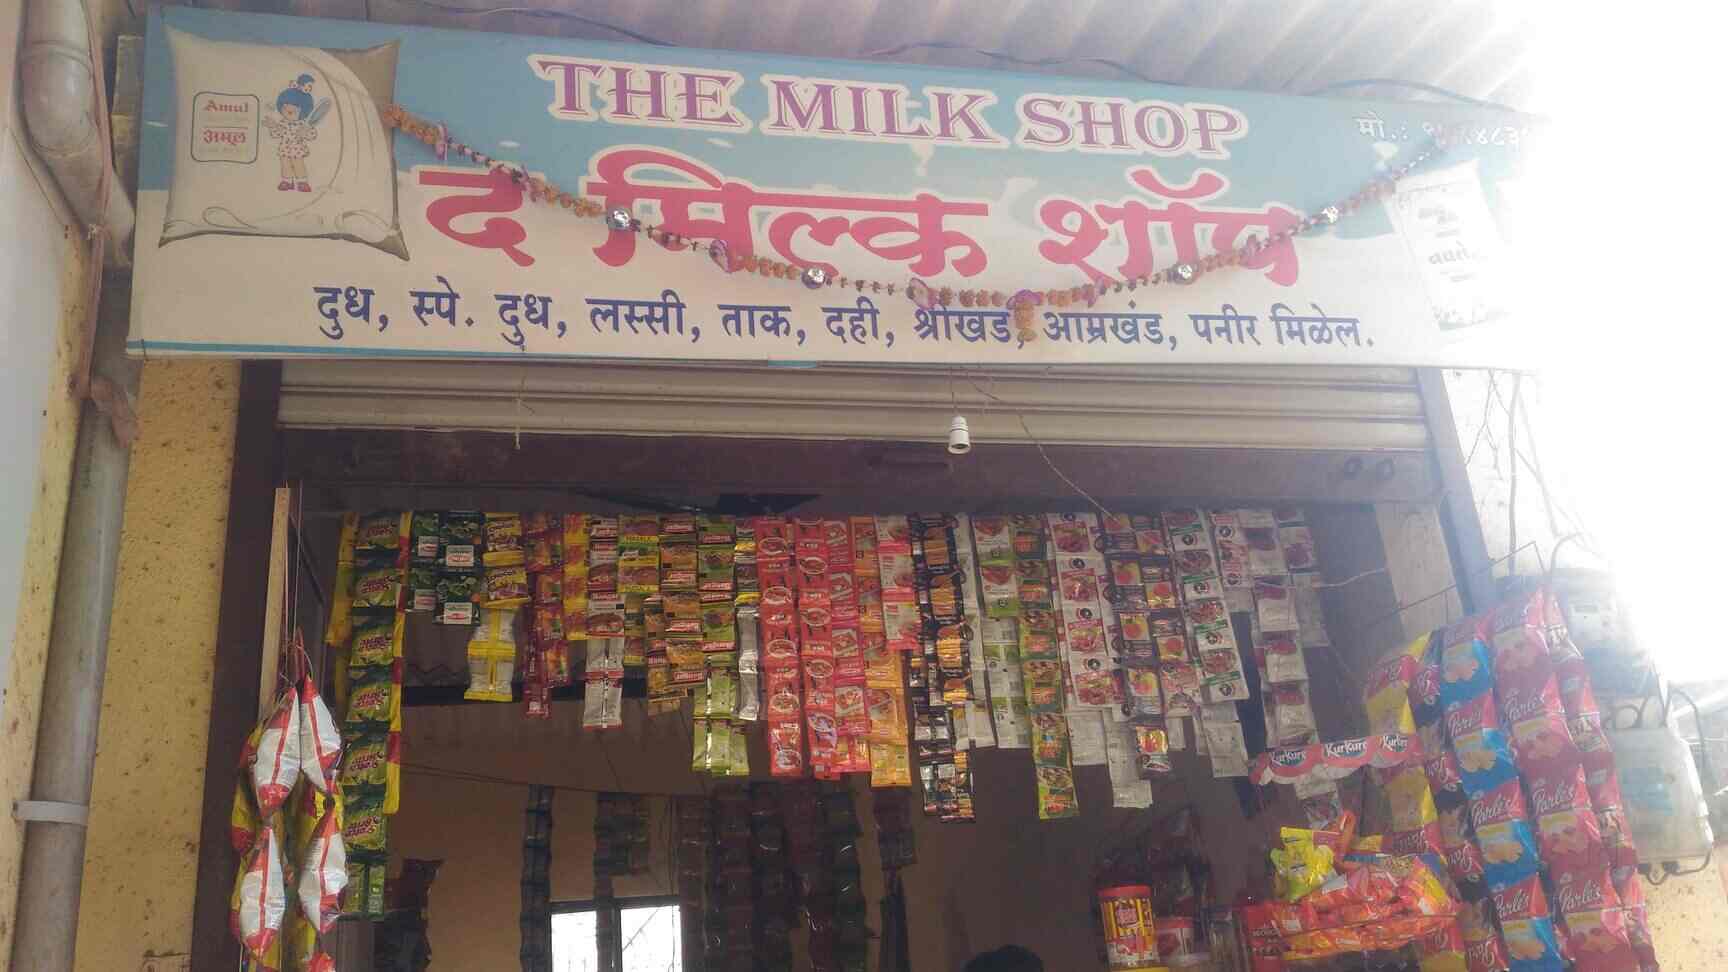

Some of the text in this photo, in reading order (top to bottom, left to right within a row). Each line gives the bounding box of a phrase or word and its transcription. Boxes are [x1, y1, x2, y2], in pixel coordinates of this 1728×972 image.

[202, 100, 249, 113] Amul
[202, 128, 247, 145] अमूल
[533, 57, 1243, 156] THE MILK SHOP
[417, 149, 1301, 287] द मिल्क शॉप
[313, 286, 389, 340] दुध,
[409, 275, 474, 327] स्पे.
[494, 294, 567, 347] दुध,
[585, 289, 701, 344] लस्सी,
[717, 304, 806, 346] ताक,
[821, 296, 895, 348] दही,
[1043, 300, 1177, 351] आम्रखंड,
[1189, 303, 1262, 346] पनीर
[1270, 302, 1375, 348] मिळेल.
